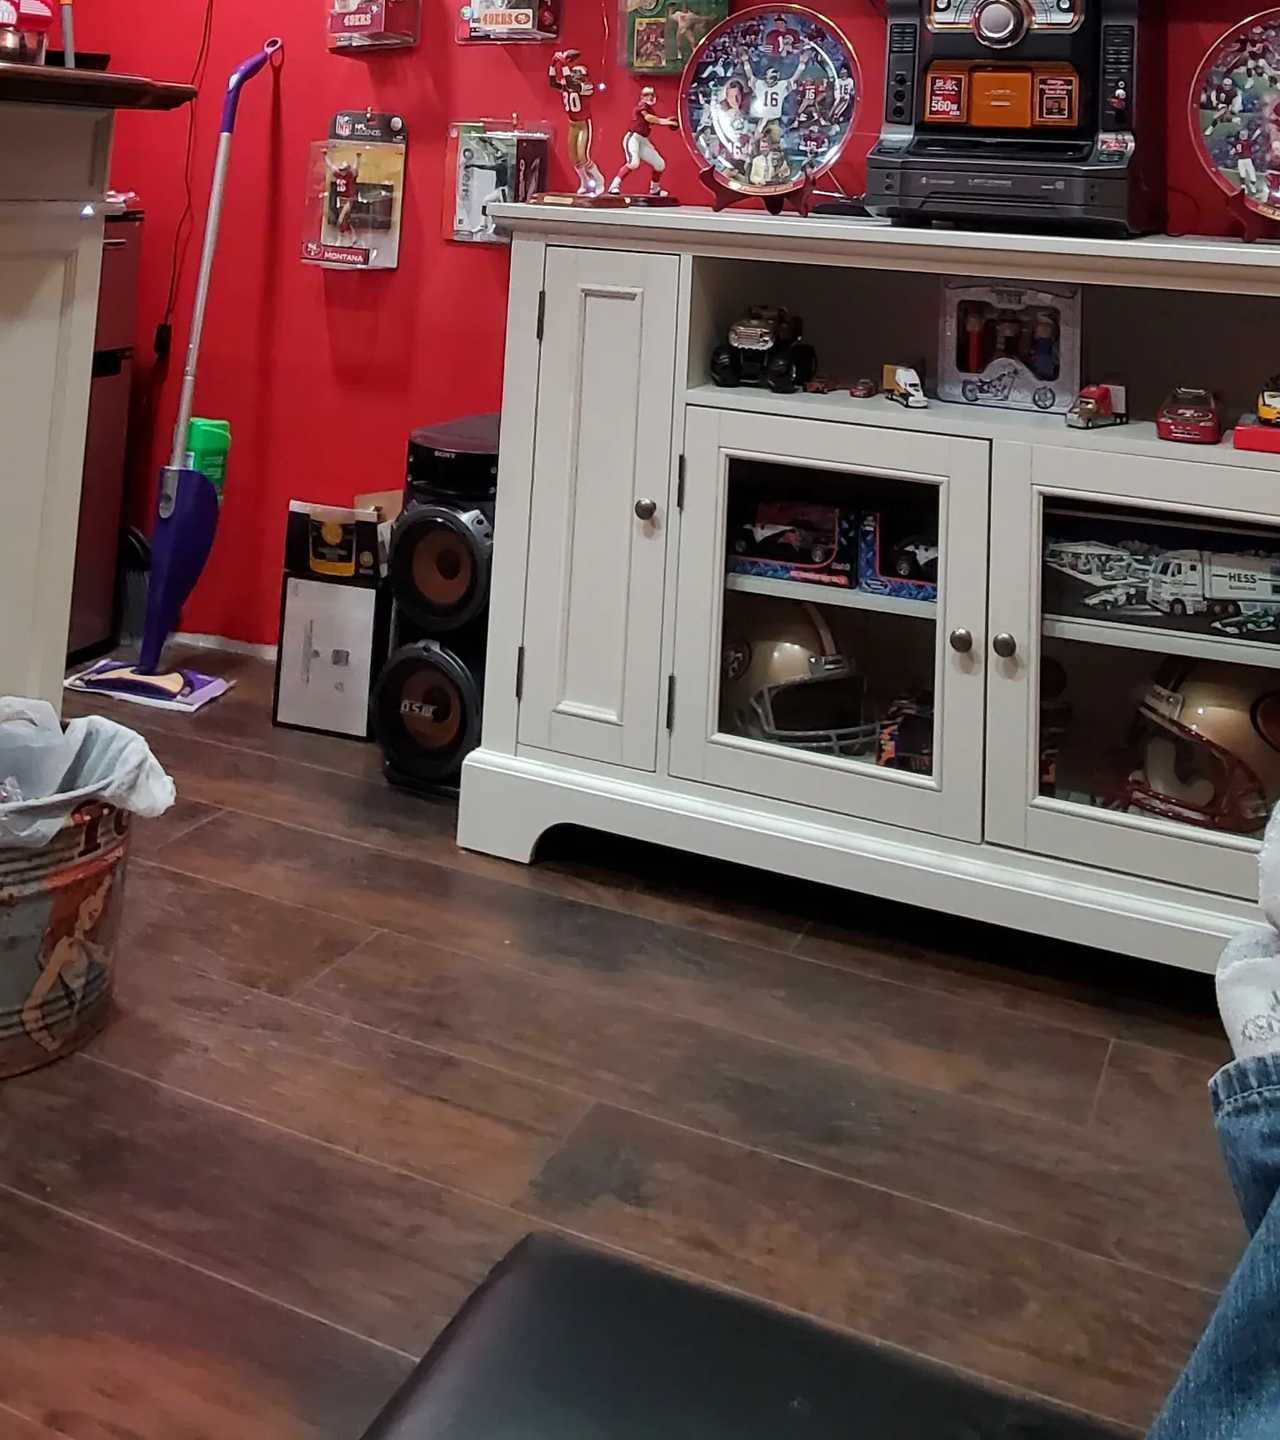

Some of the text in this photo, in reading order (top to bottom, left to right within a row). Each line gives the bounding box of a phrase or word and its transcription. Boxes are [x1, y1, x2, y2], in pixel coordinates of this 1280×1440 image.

[762, 90, 779, 109] 16
[322, 249, 365, 263] MONTANA
[1228, 572, 1257, 584] HESS
